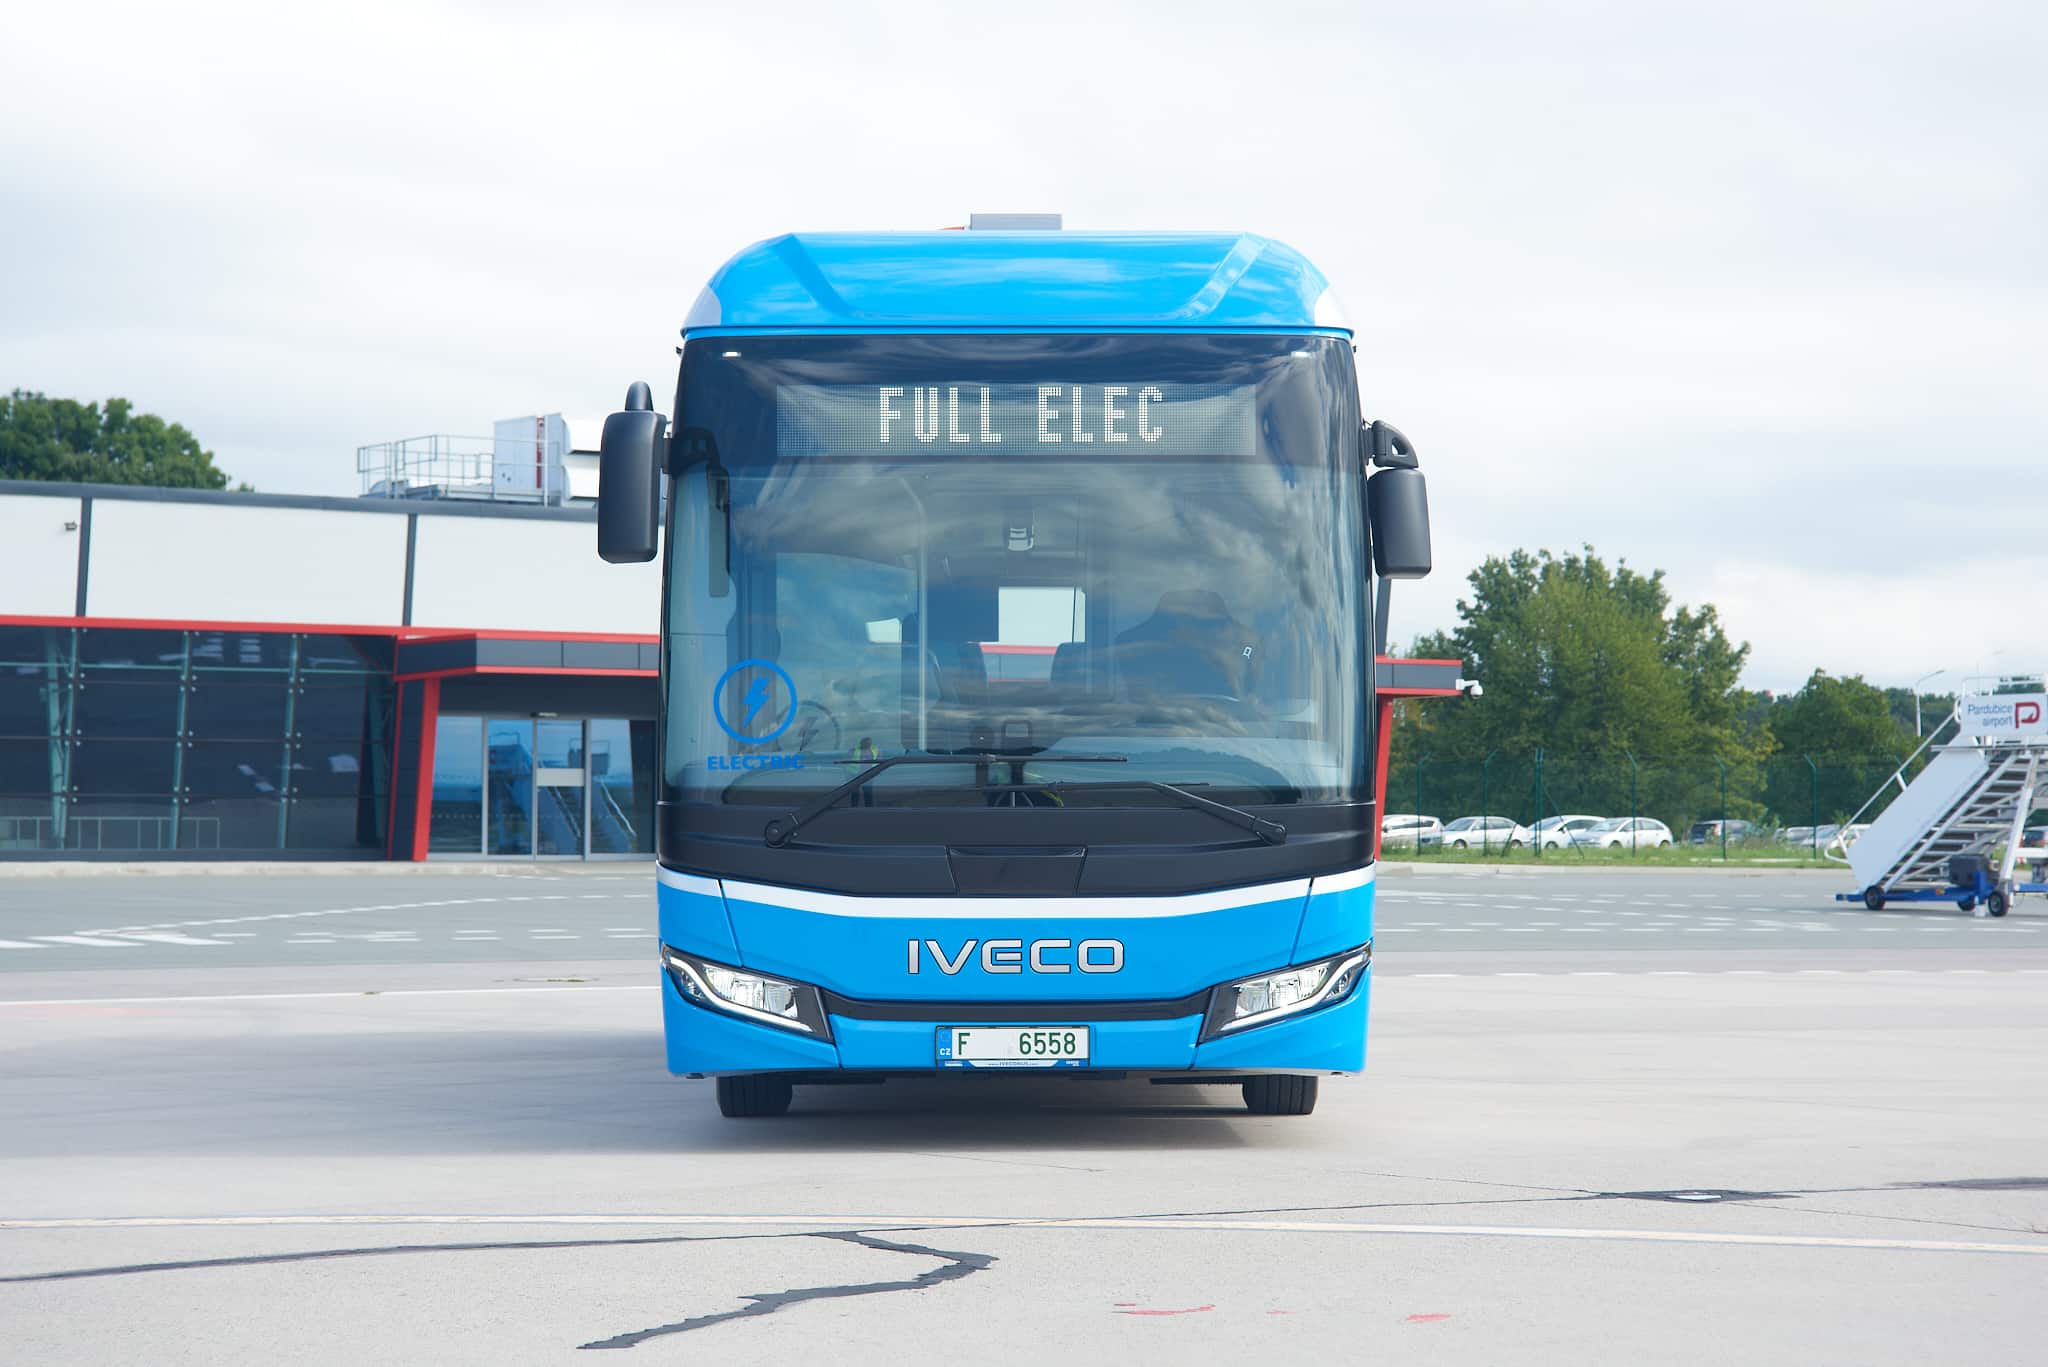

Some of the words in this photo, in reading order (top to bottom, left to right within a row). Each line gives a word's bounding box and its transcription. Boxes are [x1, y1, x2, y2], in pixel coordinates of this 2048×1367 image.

[880, 387, 1001, 442] FULL
[1039, 387, 1162, 442] ELEC
[1967, 703, 2012, 715] Pardubice
[1982, 715, 2012, 727] airport
[707, 754, 805, 771] ELECTRIC
[907, 938, 1125, 975] IVECO
[940, 1048, 952, 1056] CZ
[958, 1032, 971, 1056] F
[1019, 1032, 1076, 1056] 6558
